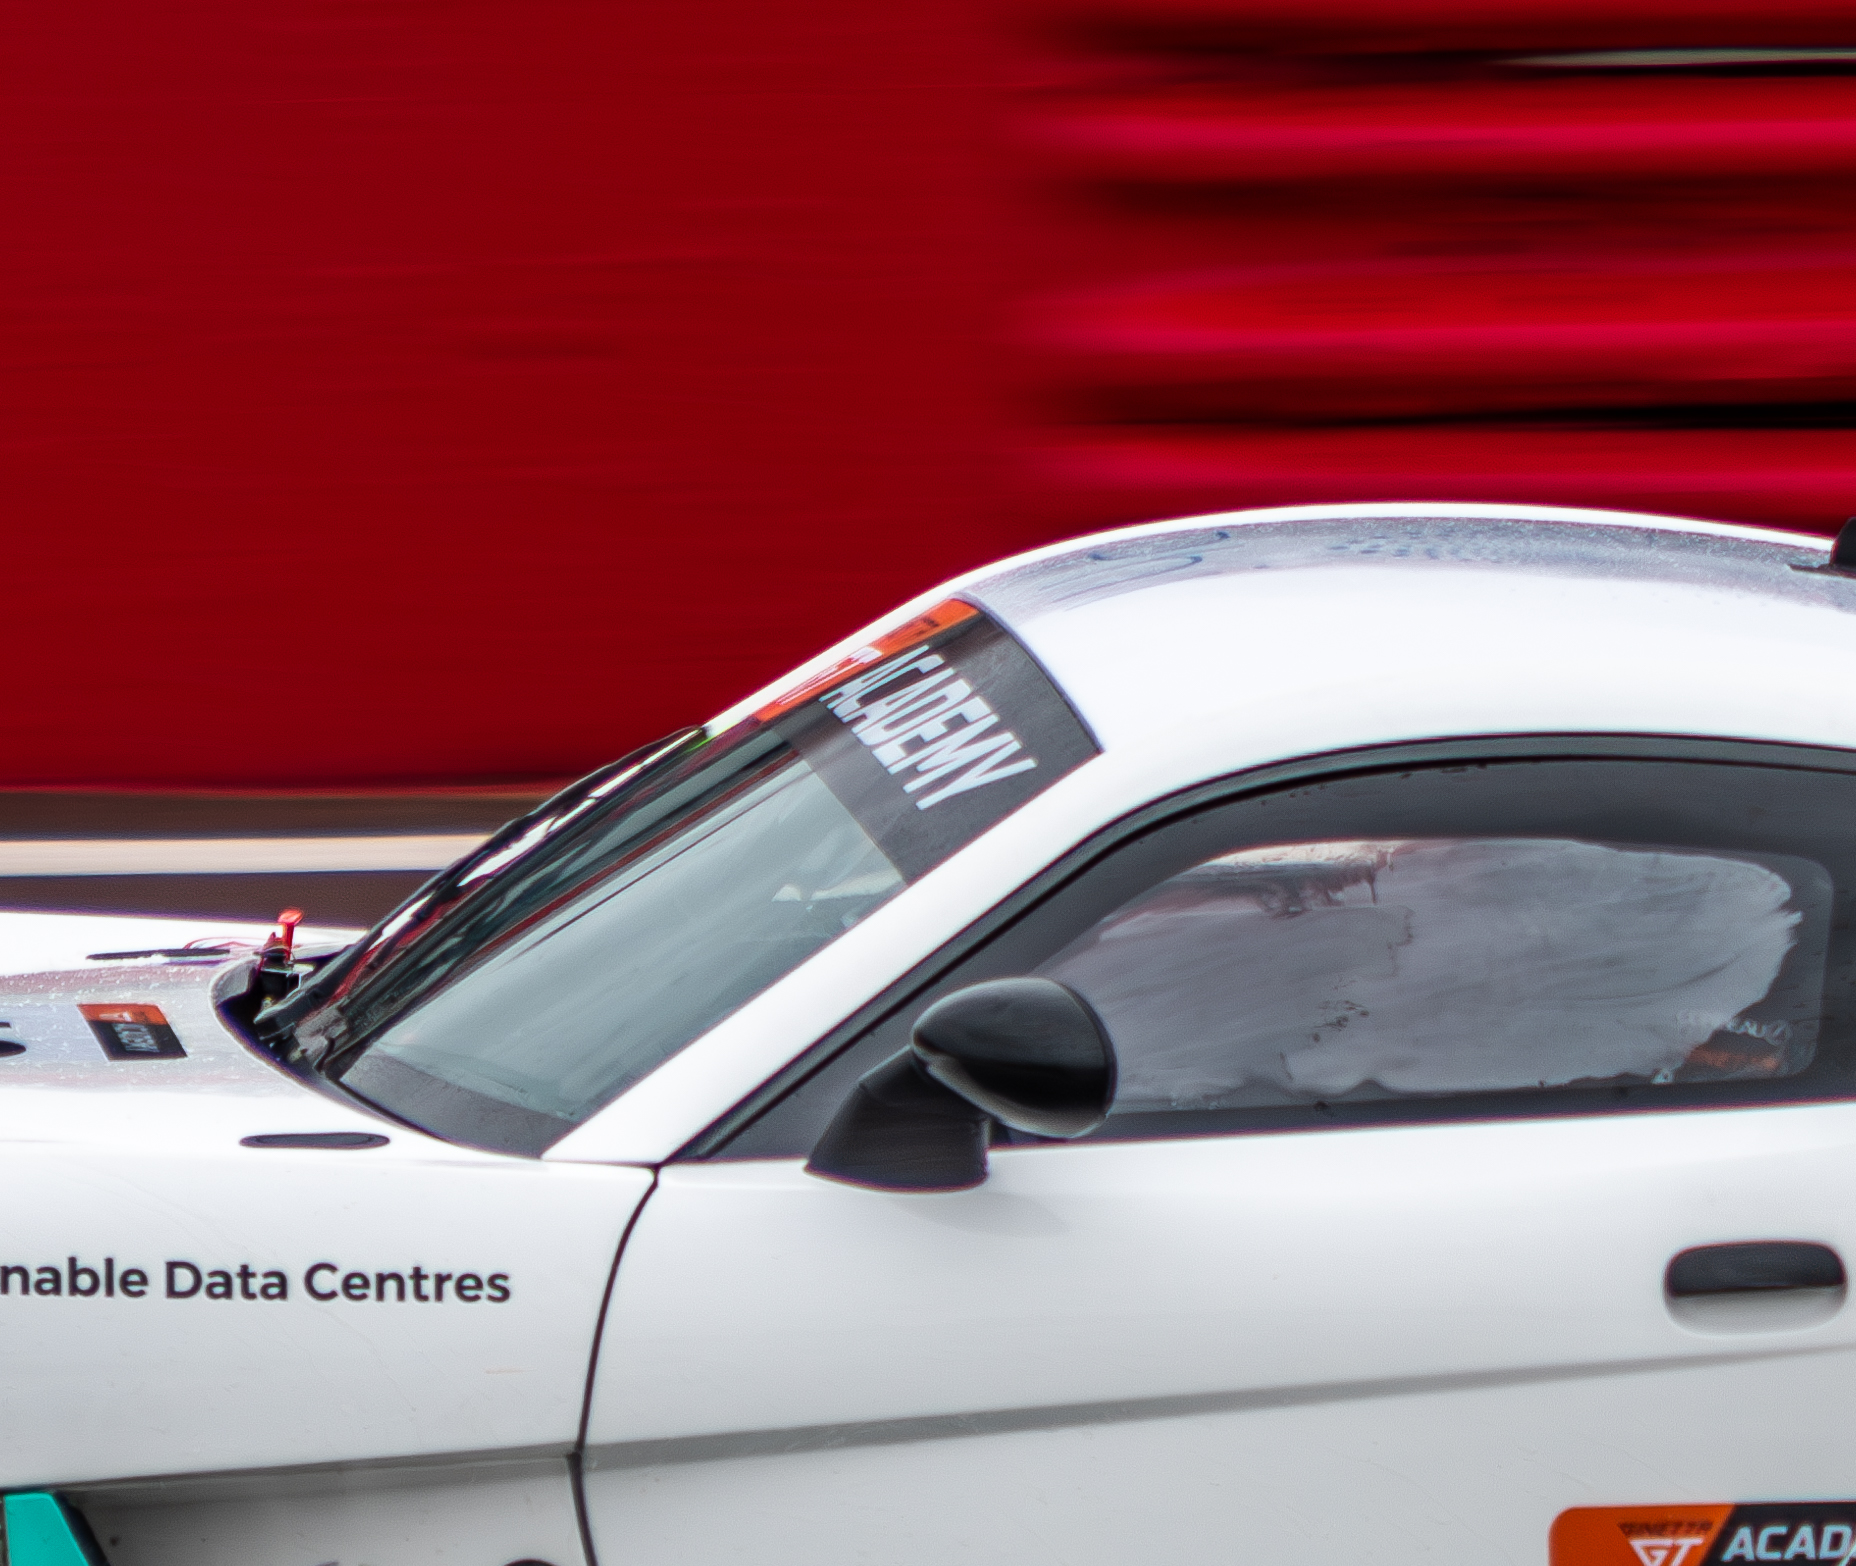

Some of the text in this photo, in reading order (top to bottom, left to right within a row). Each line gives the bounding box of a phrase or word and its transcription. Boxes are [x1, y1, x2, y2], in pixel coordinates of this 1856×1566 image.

[819, 645, 1037, 810] ACADEMY
[164, 1261, 289, 1301] Data
[303, 1263, 513, 1305] Centres
